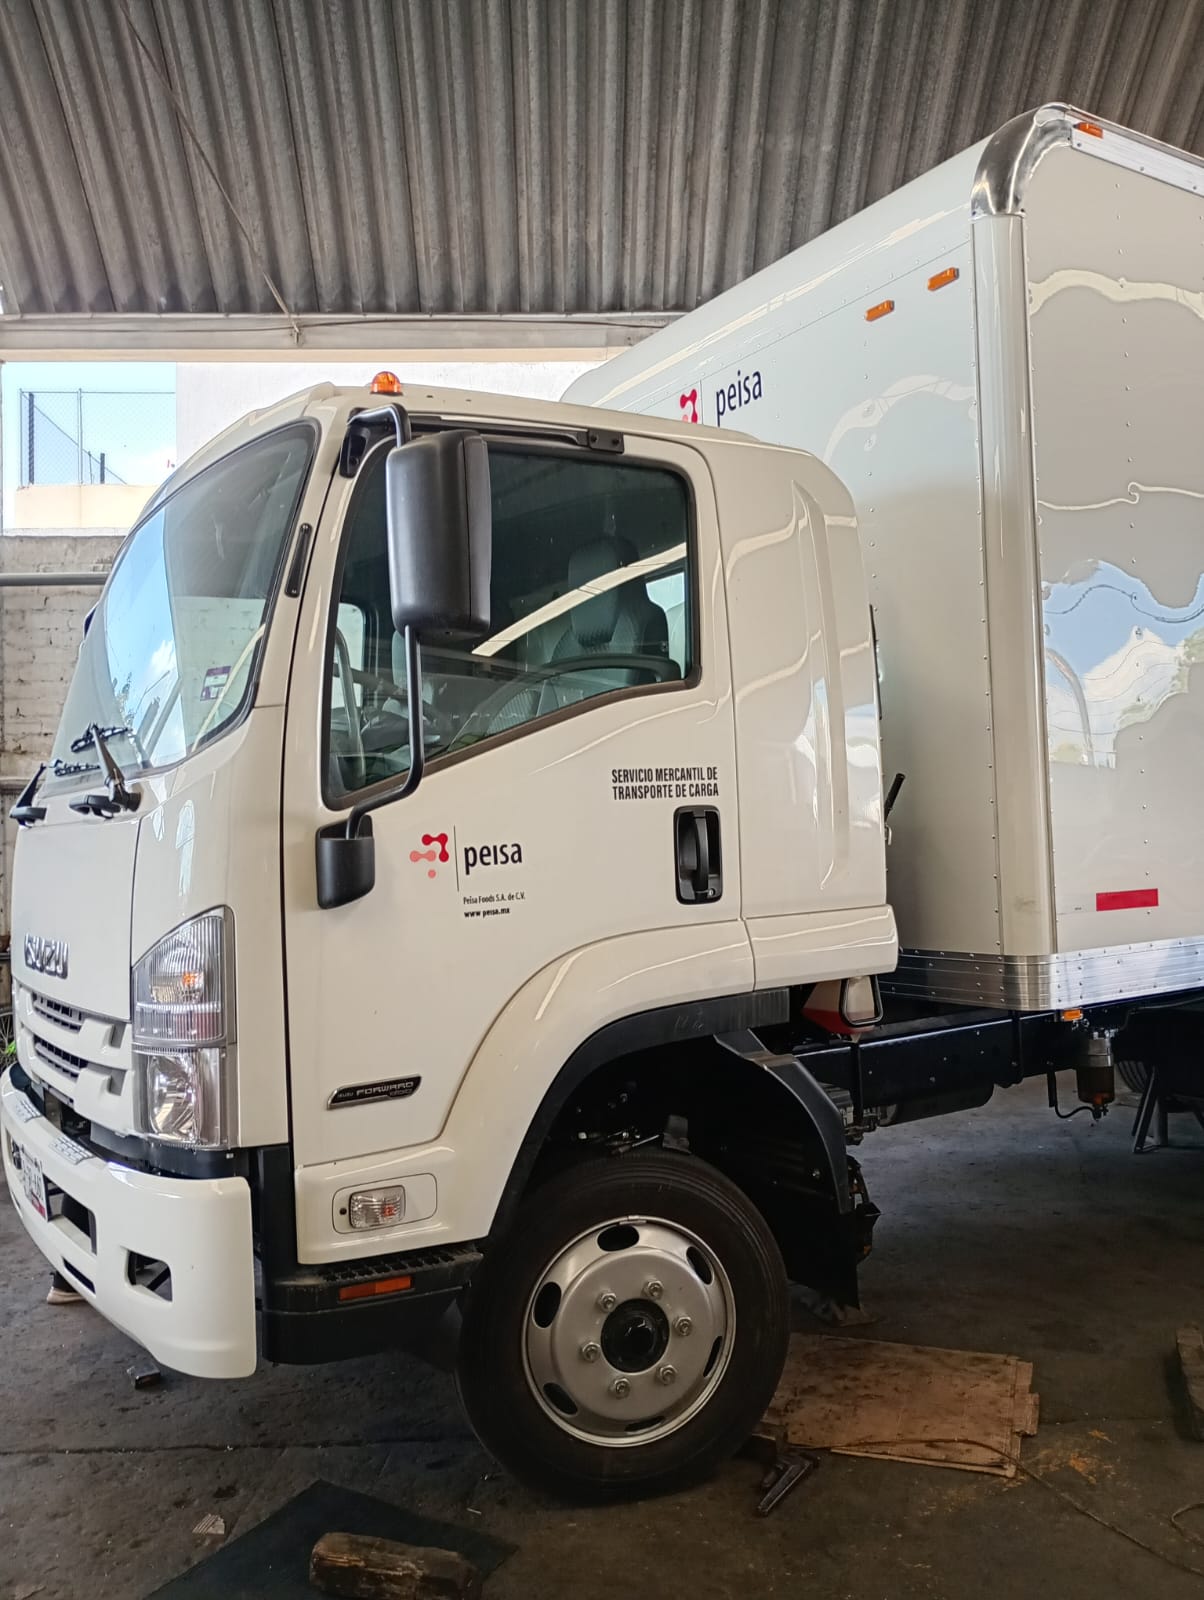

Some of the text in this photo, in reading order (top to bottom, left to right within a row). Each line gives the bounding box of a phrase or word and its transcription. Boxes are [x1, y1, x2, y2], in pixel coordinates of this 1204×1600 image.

[716, 369, 762, 427] peisa
[611, 766, 718, 783] SERVICIO MERCANTIL DE
[612, 782, 719, 800] TRANSPORTE DE CARGA
[463, 891, 525, 904] Peisa Foods S.A. de C.V.
[24, 933, 69, 980] ISUZU
[356, 1081, 414, 1096] FORWARD
